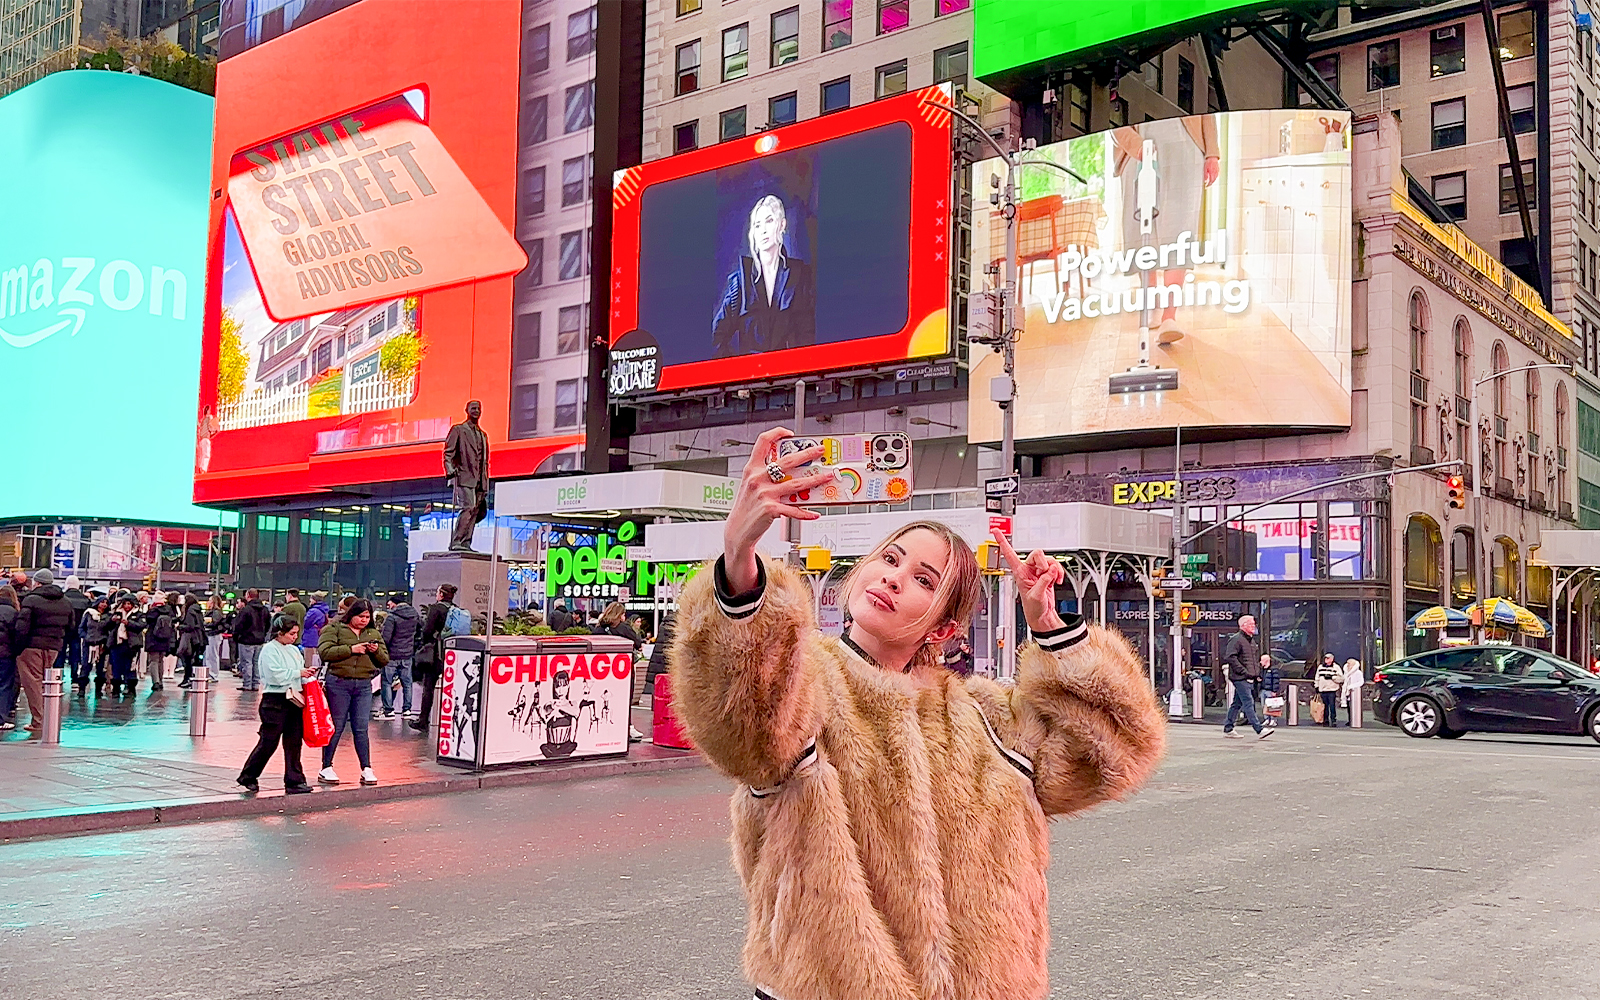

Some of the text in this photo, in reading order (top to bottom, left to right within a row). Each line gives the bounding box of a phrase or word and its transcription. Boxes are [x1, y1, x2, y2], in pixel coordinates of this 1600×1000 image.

[261, 141, 437, 235] STREET
[282, 223, 371, 267] GLOBAL
[1060, 231, 1227, 283] Powerful
[296, 246, 423, 299] ADVISORS
[1465, 240, 1497, 283] MILLER
[0, 257, 187, 321] mazon
[1041, 273, 1250, 324] Vacuuming
[354, 362, 369, 373] FOR
[611, 347, 657, 360] WELCOME TO
[628, 359, 657, 374] TIMES
[610, 371, 656, 395] SQUARE
[1113, 477, 1237, 505] EXPRESS
[563, 585, 619, 597] SOCCER
[1115, 611, 1161, 620] EXPRESS
[1199, 611, 1233, 620] PRESS
[490, 653, 631, 684] CHICAGO
[439, 650, 456, 756] CHICAGO
